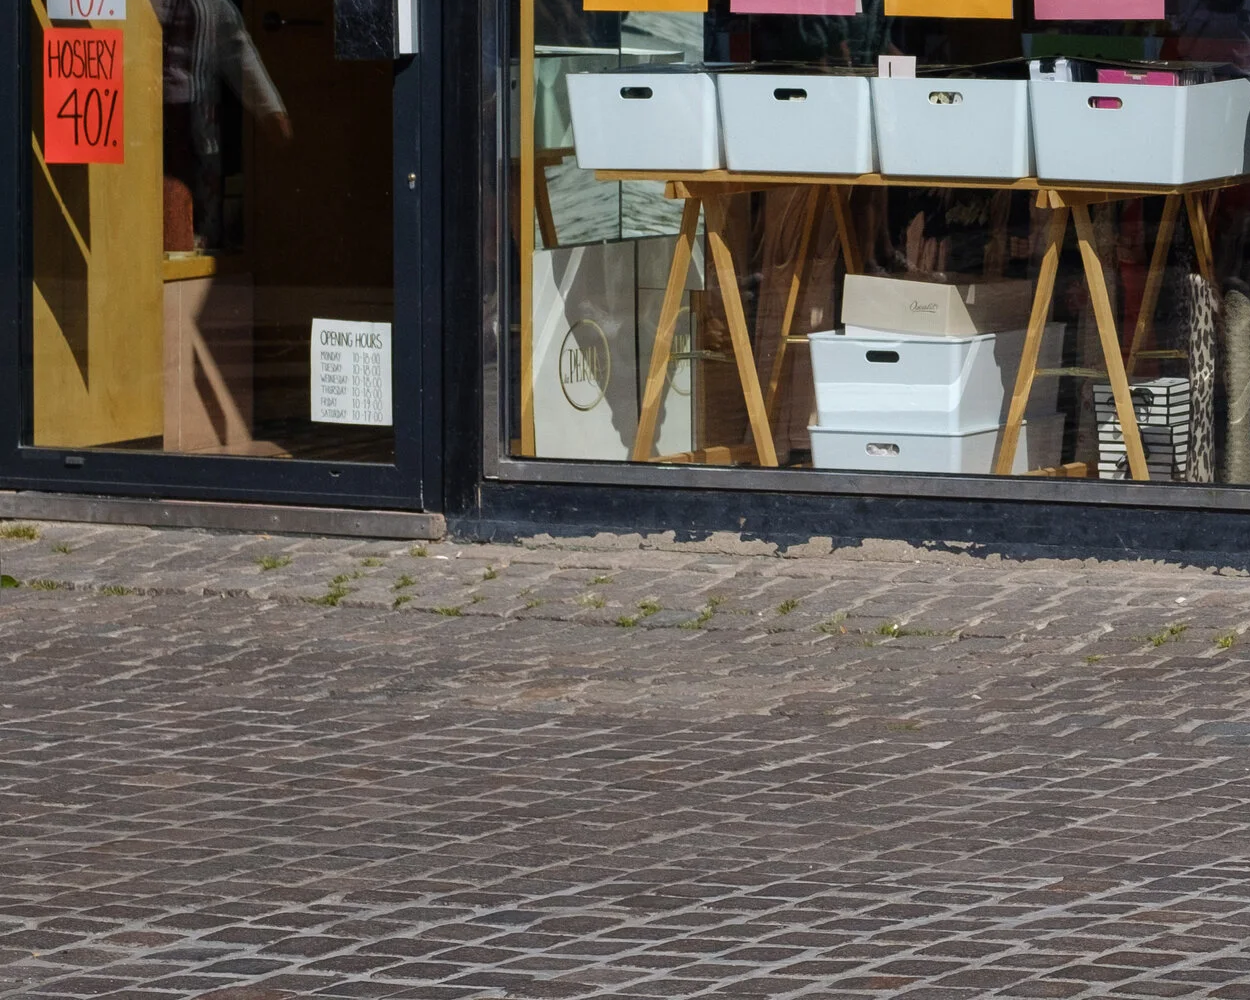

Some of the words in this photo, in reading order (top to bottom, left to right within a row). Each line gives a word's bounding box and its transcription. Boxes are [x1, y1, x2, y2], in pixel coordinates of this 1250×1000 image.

[48, 39, 116, 80] HOSIERY
[57, 88, 118, 147] 40%
[320, 330, 353, 348] OPENING
[355, 333, 383, 349] HOURS
[320, 351, 341, 362] MONDAY
[320, 362, 342, 373] TUESDAY
